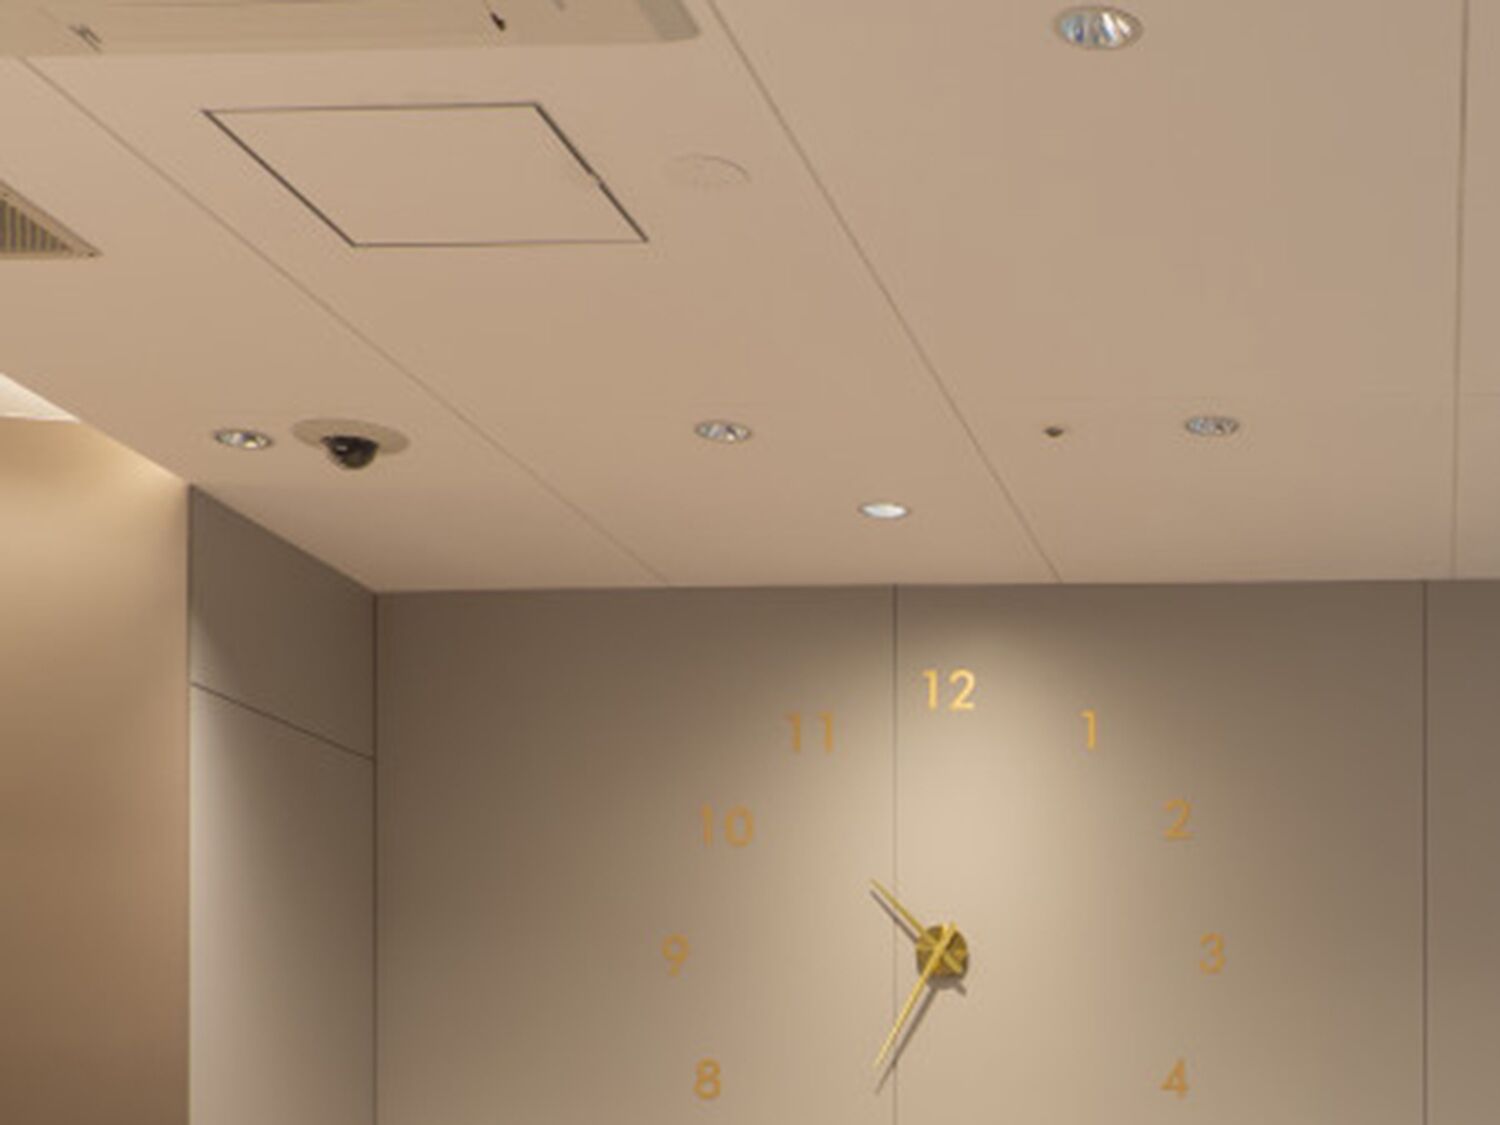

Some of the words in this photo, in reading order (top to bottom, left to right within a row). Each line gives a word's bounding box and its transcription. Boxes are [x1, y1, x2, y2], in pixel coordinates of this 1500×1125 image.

[921, 668, 976, 712] 12
[787, 711, 835, 753] 11
[1080, 709, 1098, 751] 1
[699, 804, 754, 847] 10
[1163, 799, 1193, 841] 2
[661, 933, 690, 976] 9
[1199, 933, 1227, 975] 3
[693, 1057, 722, 1100] 8
[1161, 1059, 1189, 1099] 4
